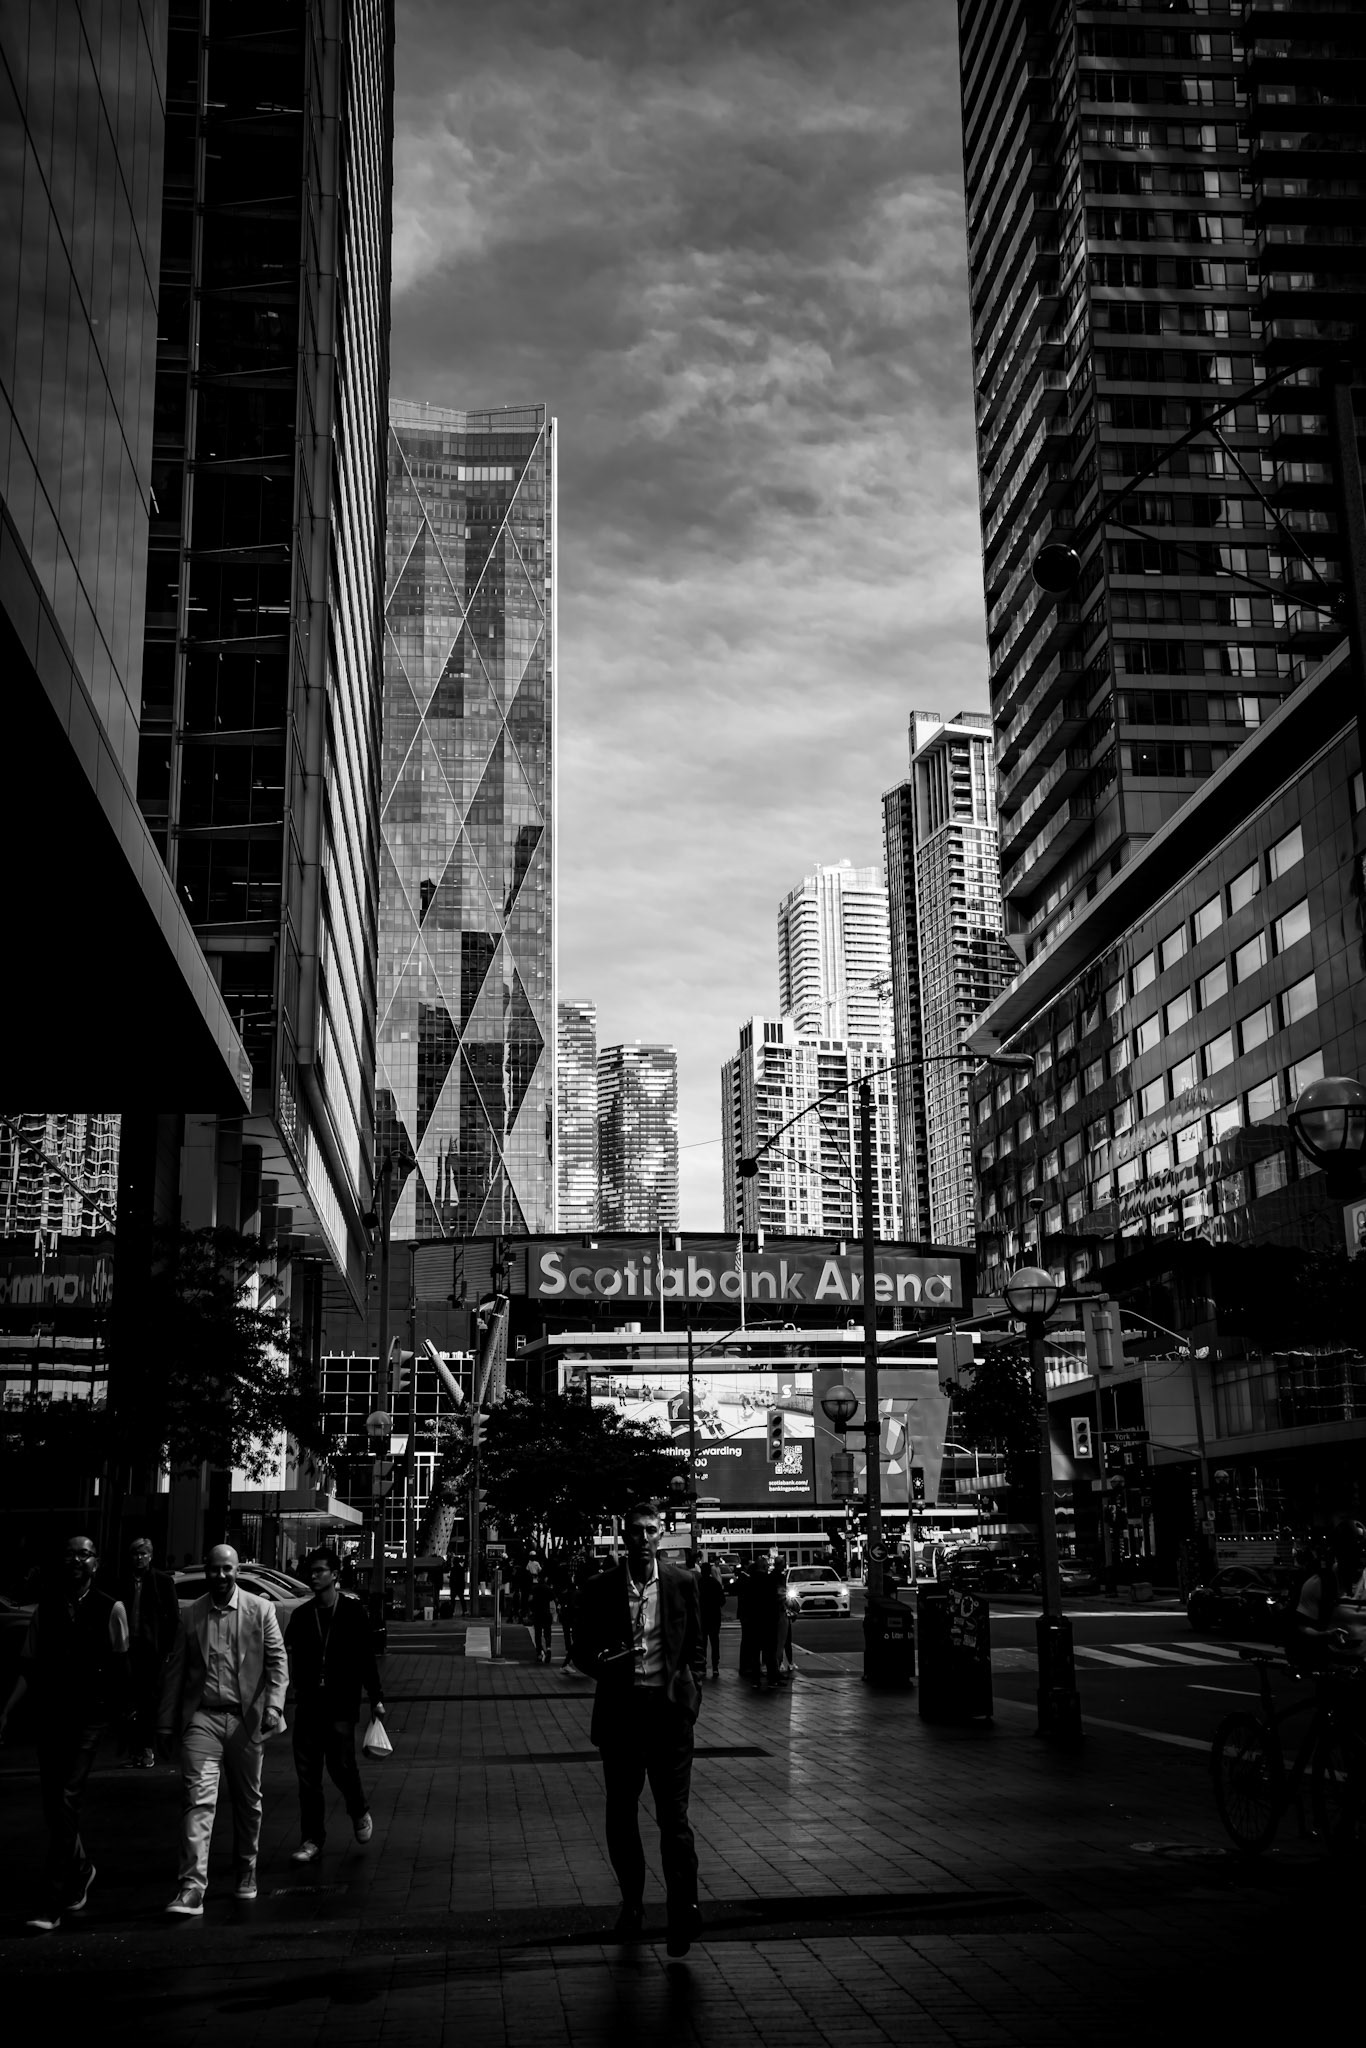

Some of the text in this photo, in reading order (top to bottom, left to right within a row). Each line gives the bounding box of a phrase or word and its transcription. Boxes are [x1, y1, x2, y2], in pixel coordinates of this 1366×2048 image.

[539, 1250, 953, 1303] Scotiabank Arena
[1114, 1433, 1131, 1441] York
[720, 1526, 753, 1534] Arena
